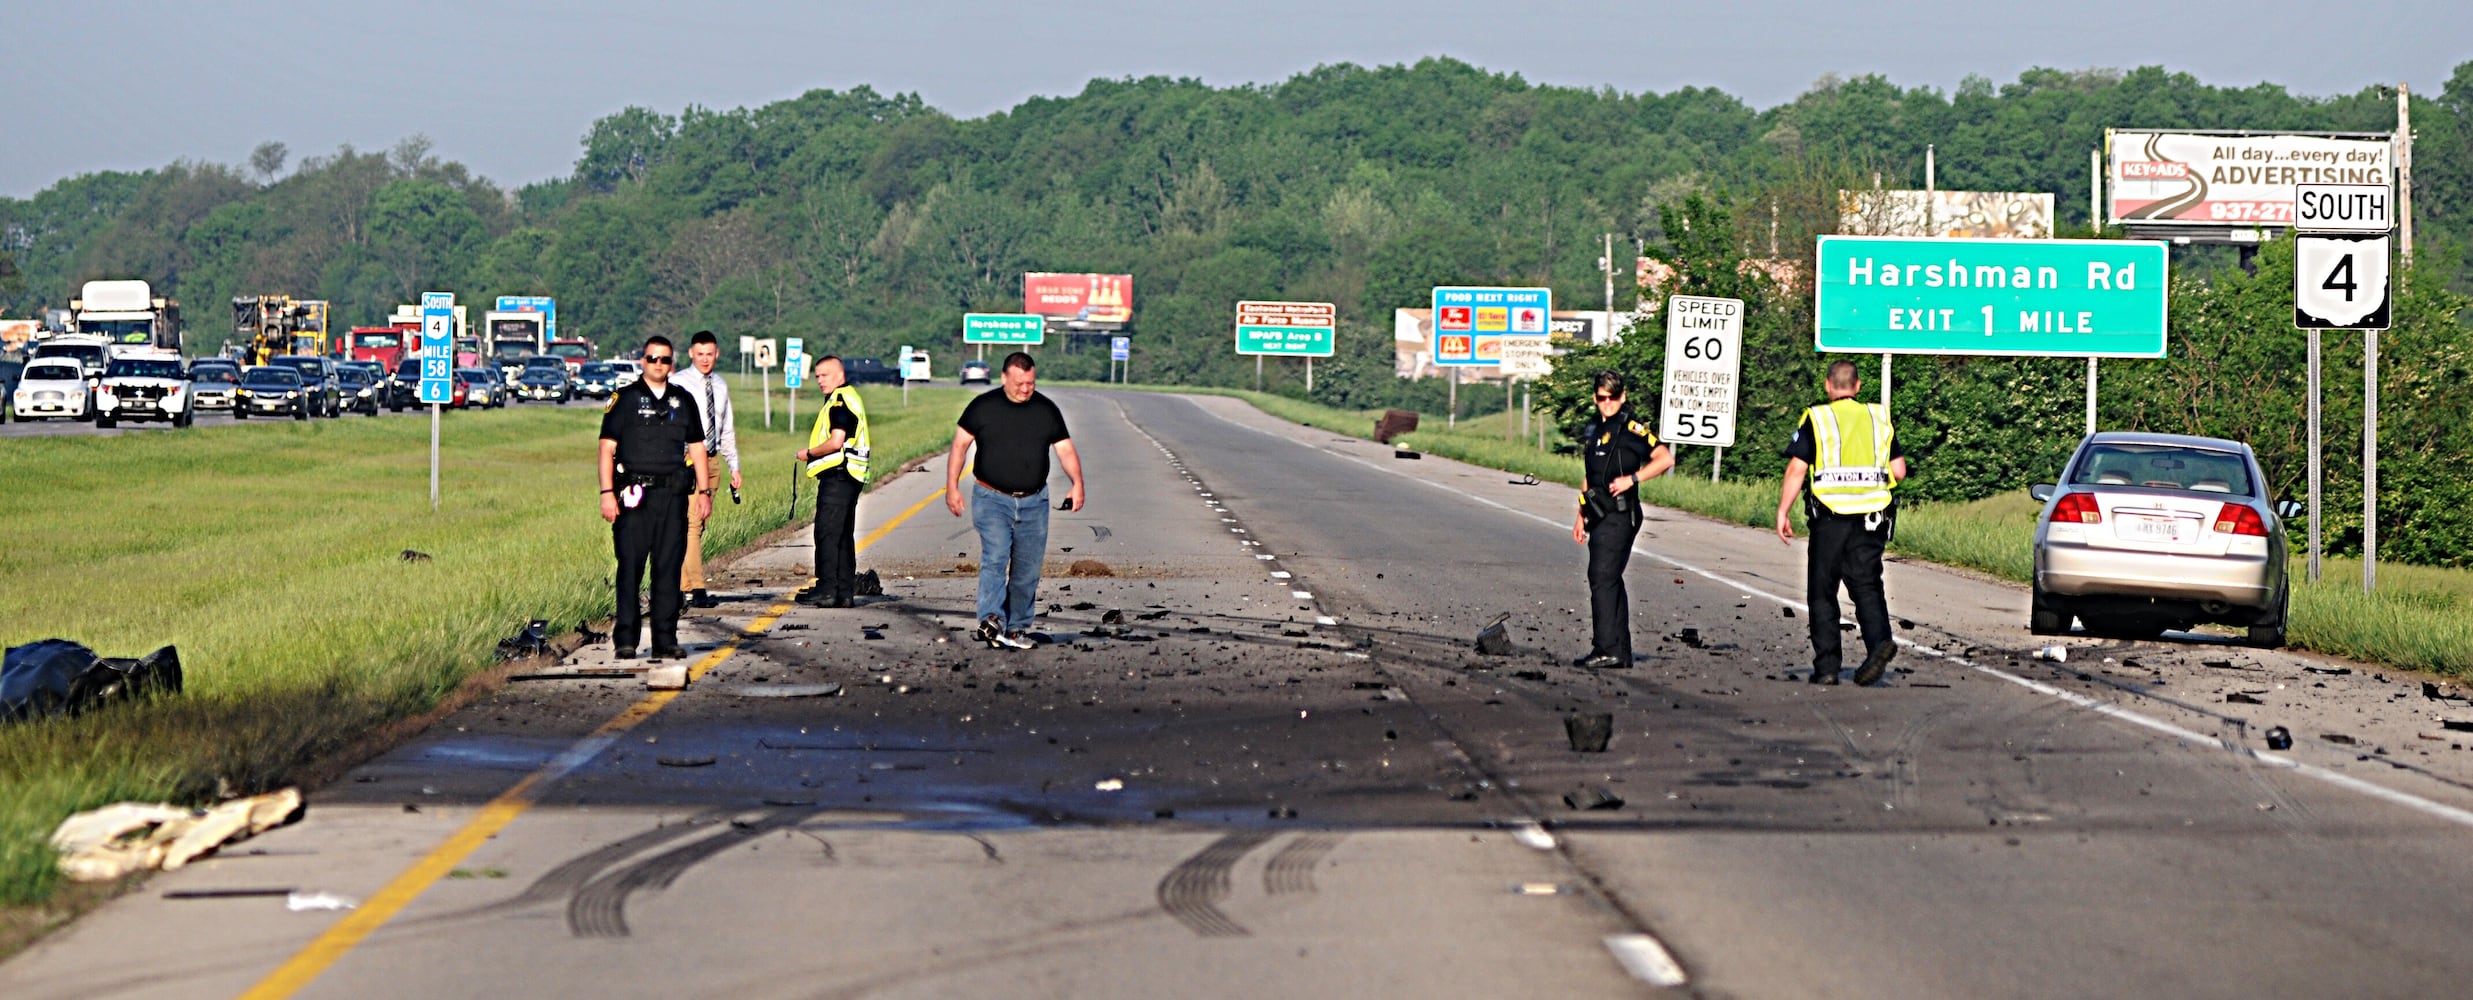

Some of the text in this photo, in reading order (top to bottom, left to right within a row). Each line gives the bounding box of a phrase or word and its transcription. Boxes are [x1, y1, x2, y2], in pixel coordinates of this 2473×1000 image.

[2213, 146, 2235, 161] All
[2346, 148, 2383, 165] day!
[2211, 166, 2384, 185] ADVERTISING
[2301, 190, 2385, 221] SOUTH
[1849, 257, 2136, 290] Harshman Rd
[2322, 253, 2358, 302] 4
[424, 295, 451, 309] SOUTH
[1445, 293, 1539, 303] FOOD NEXT RIGHT
[1677, 301, 1736, 316] SPEED
[433, 321, 440, 332] 4
[1025, 321, 1037, 330] Rd
[1682, 316, 1728, 330] LIMIT
[1889, 305, 2093, 336] EXIT 1 MILE
[424, 345, 449, 358] MILE
[1684, 336, 1722, 360] 60
[428, 360, 446, 377] 58
[1674, 370, 1730, 385] VEHICLES OVER
[431, 382, 440, 398] 6
[1680, 385, 1699, 397] TONS
[1703, 386, 1728, 398] EMPTY
[1670, 398, 1729, 413] NON COM BUSES
[1677, 413, 1718, 439] 55
[1821, 472, 1859, 481] DAYTON
